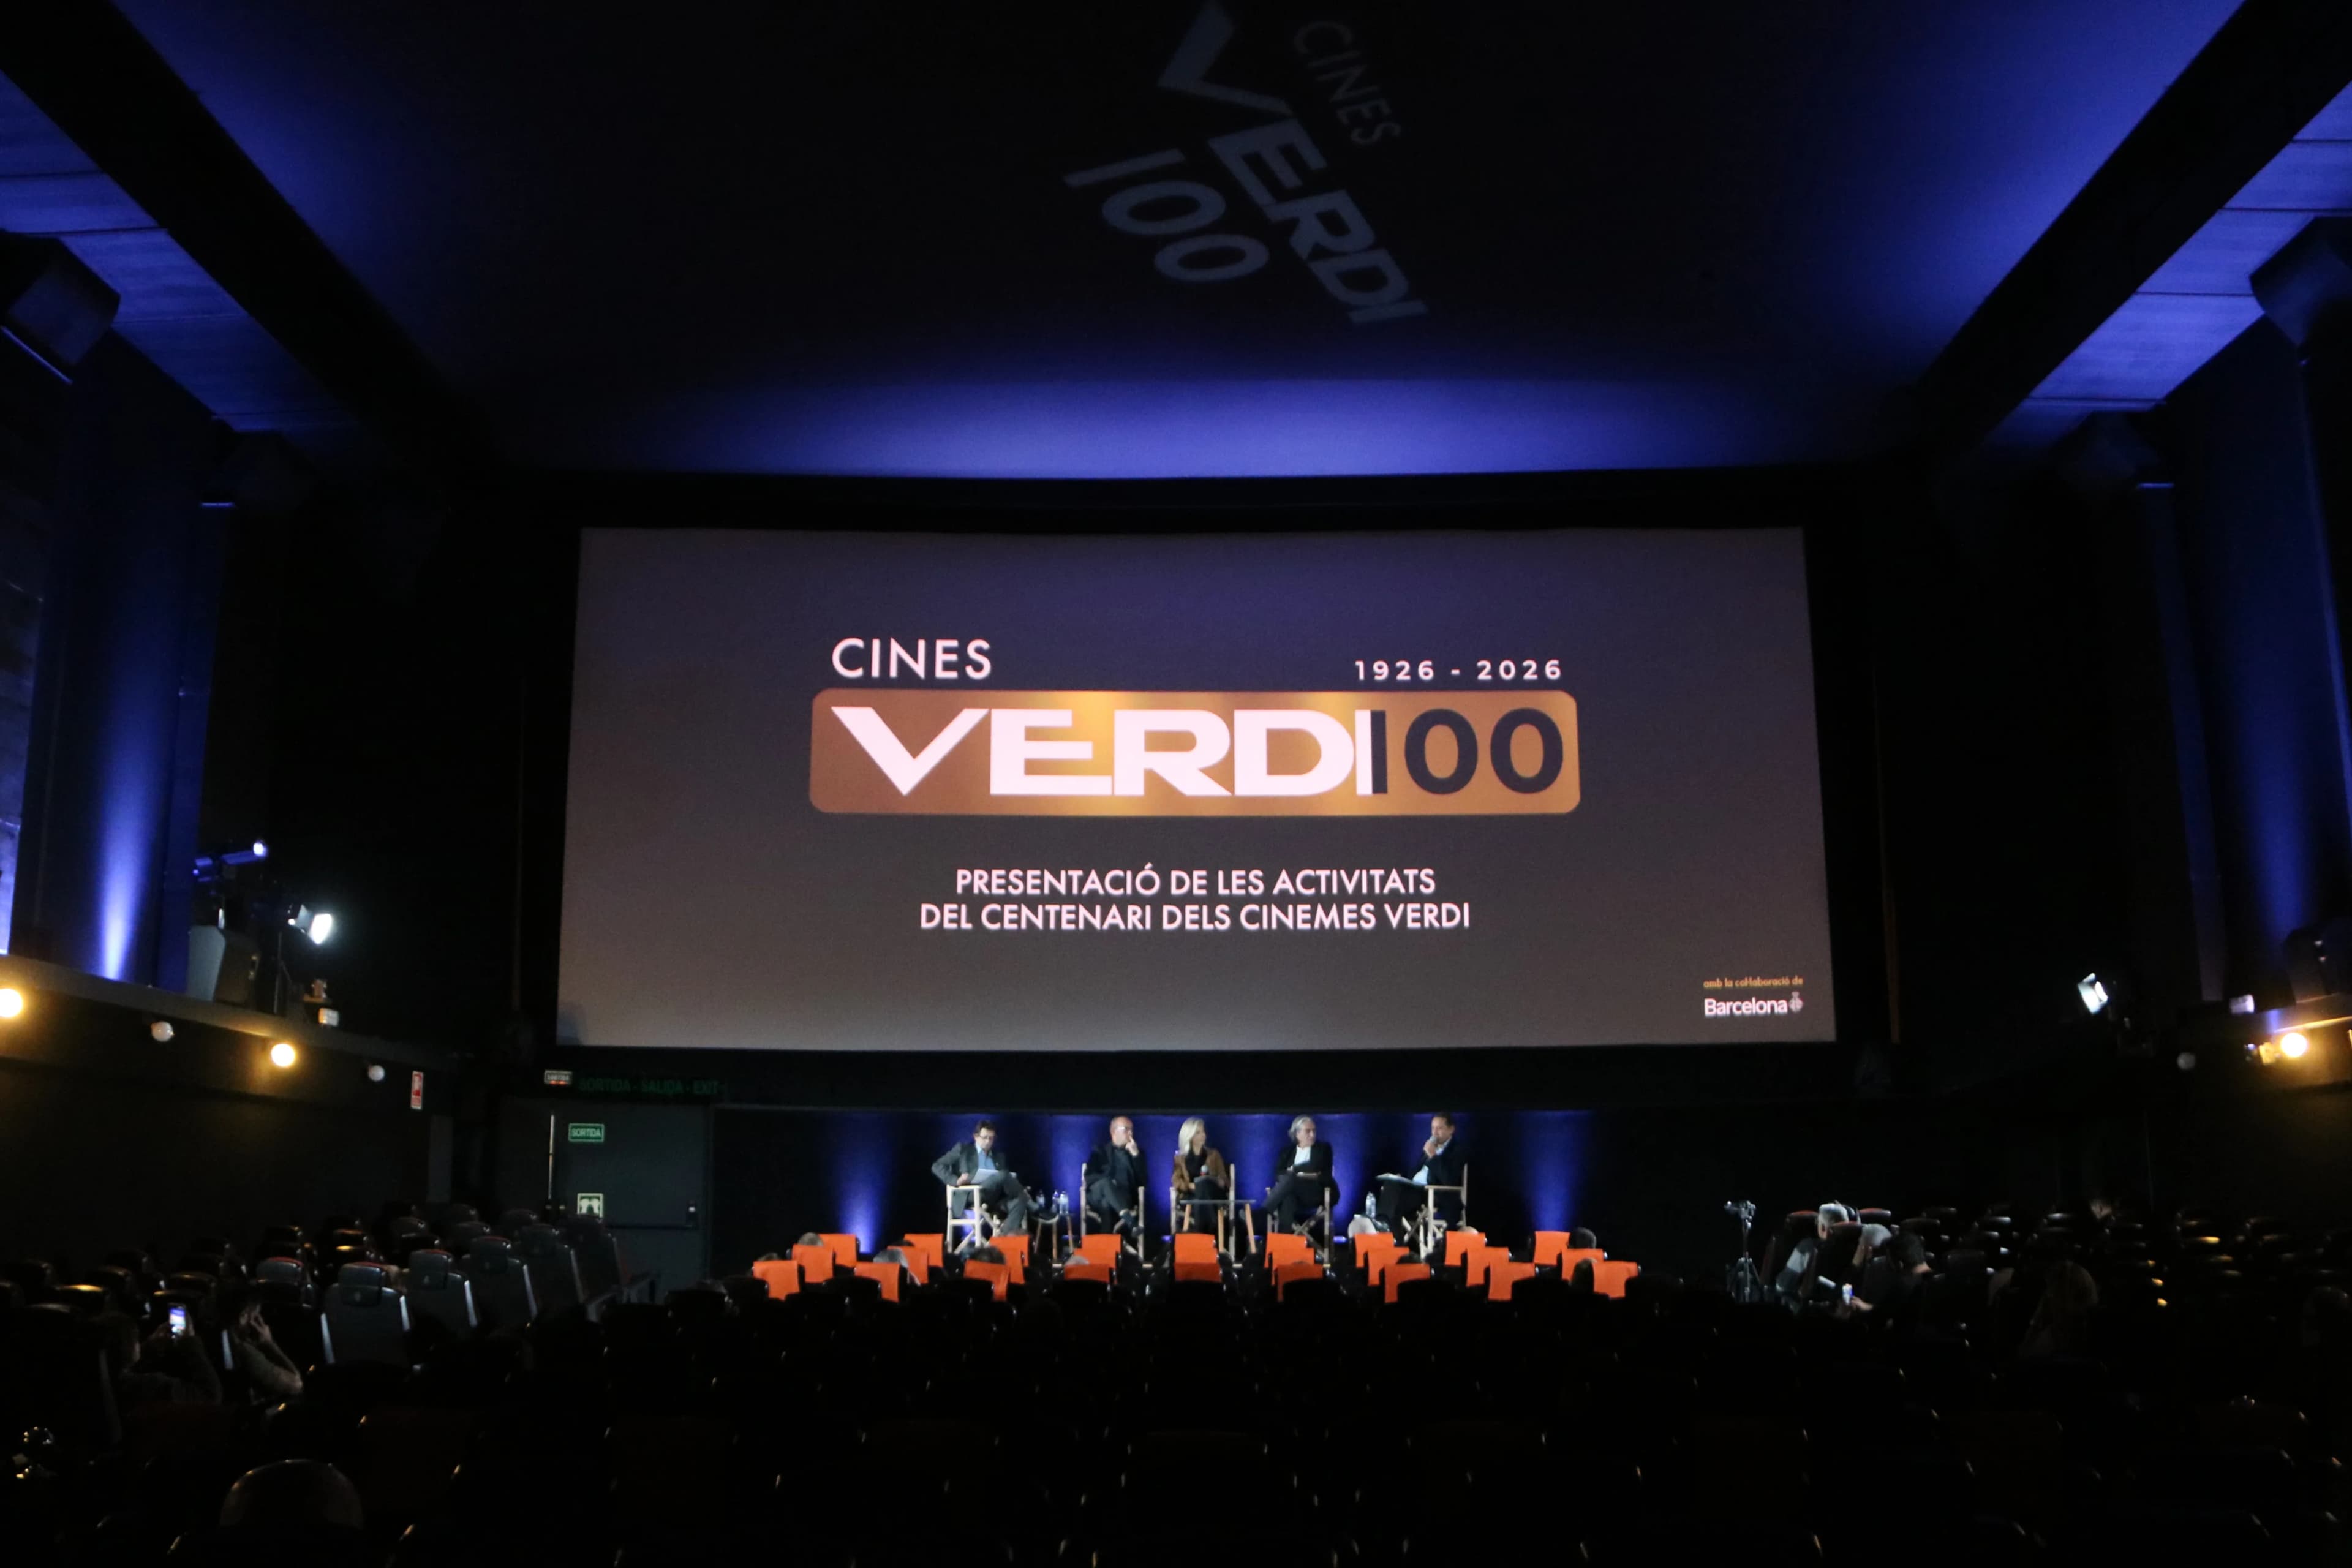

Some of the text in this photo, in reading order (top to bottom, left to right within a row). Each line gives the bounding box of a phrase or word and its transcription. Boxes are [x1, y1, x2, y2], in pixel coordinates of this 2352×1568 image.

[1293, 20, 1402, 147] CINES
[1157, 0, 1429, 325] VERDI
[1063, 147, 1271, 283] 100
[832, 637, 992, 679] CINES
[1355, 660, 1434, 681] 1926
[1477, 659, 1561, 680] 2026
[831, 706, 1373, 796] VERDI
[957, 862, 1436, 895] PRESENTACIÓ DE LES ACTIVITATS
[921, 902, 1470, 930] DEL CENTENARI DELS CINEMES VERDI
[1703, 978, 1722, 989] amb
[1725, 978, 1733, 988] la
[1792, 975, 1804, 986] de
[1704, 997, 1789, 1016] Barcelona
[571, 1128, 601, 1137] SORTIDA
